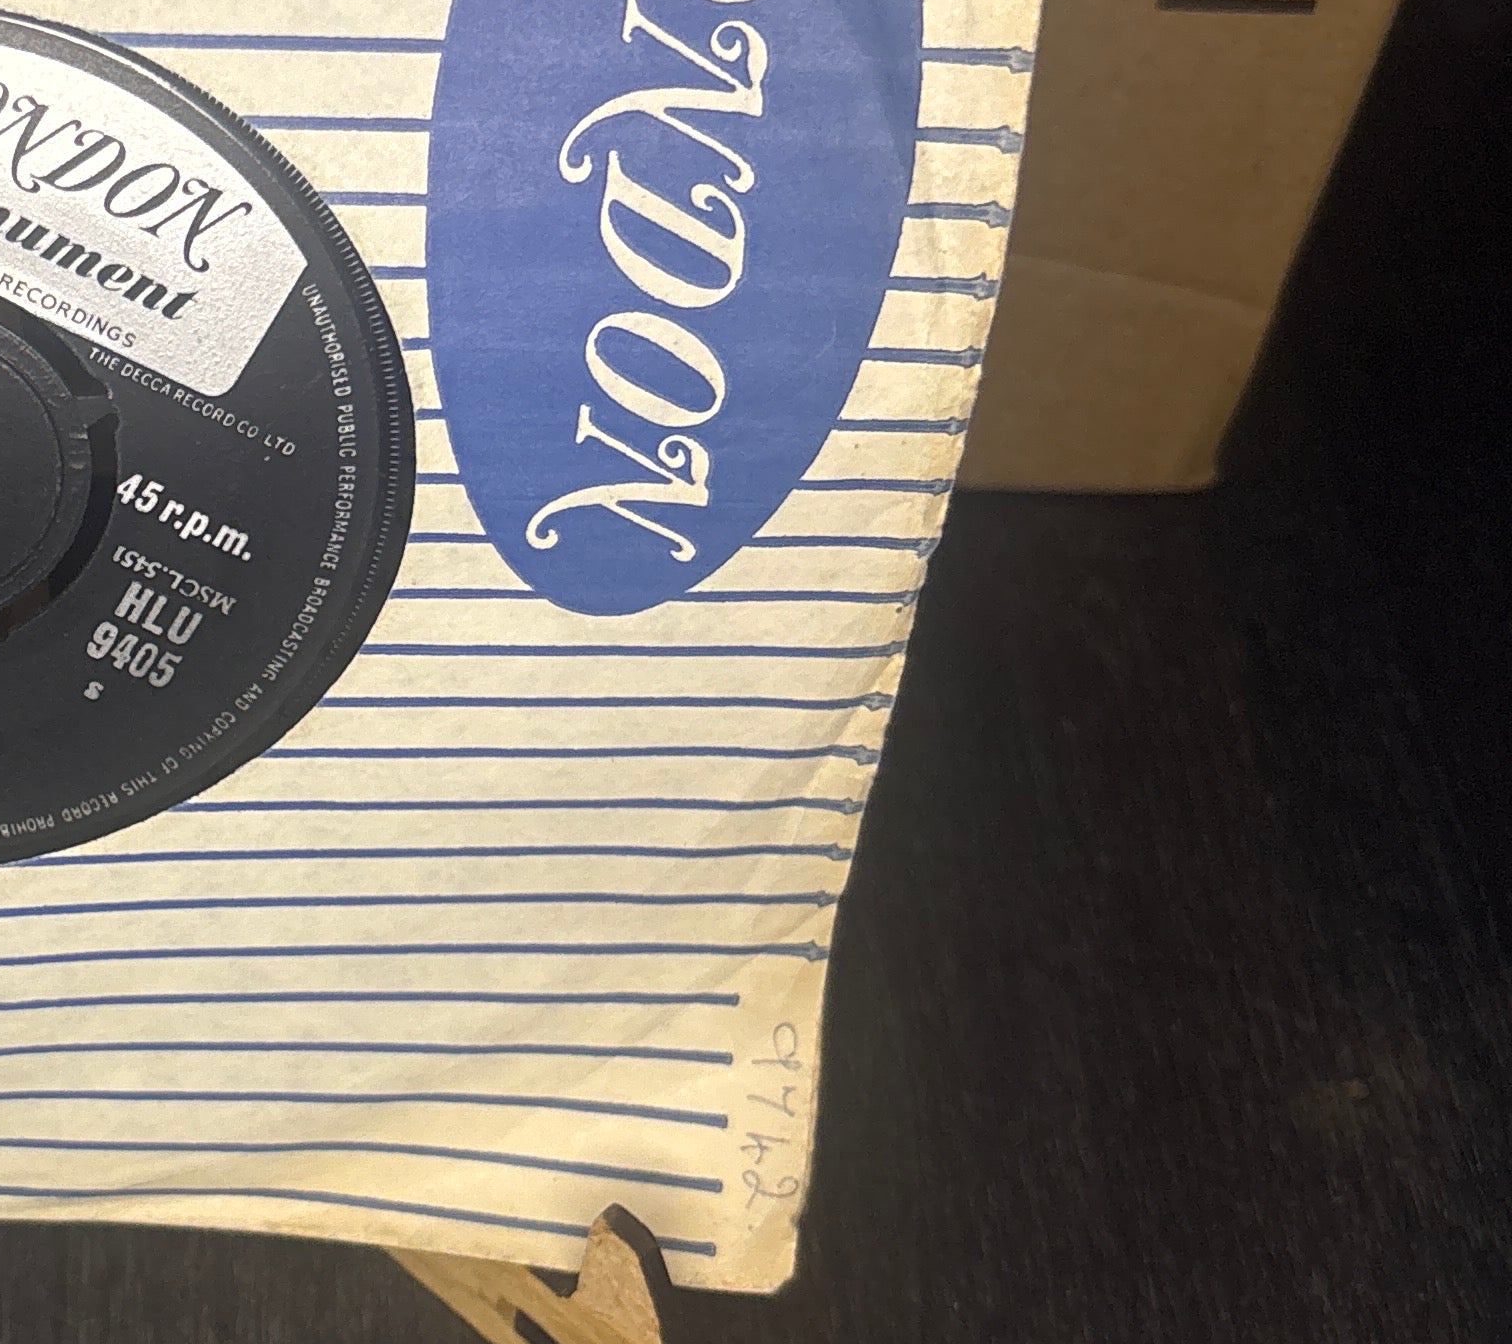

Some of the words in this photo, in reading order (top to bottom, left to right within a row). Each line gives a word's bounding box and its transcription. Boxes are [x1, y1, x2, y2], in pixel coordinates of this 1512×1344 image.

[301, 283, 353, 398] UNAUTHORISED
[88, 346, 121, 371] THE
[120, 362, 172, 396] DECCA
[172, 388, 236, 427] RECORD
[236, 419, 260, 439] CO
[263, 433, 297, 457] LTD
[336, 403, 357, 458] PUBLIC
[116, 473, 165, 514] 45
[158, 499, 252, 562] r.p.m.
[319, 465, 357, 571] PERFORMANCE
[113, 580, 203, 645] HLU
[261, 575, 331, 682] BROADCASTING
[85, 620, 183, 688] 9405
[234, 682, 264, 712] AND
[178, 710, 237, 760] COPYING
[61, 791, 119, 823] RECORD
[120, 770, 159, 797] THIS
